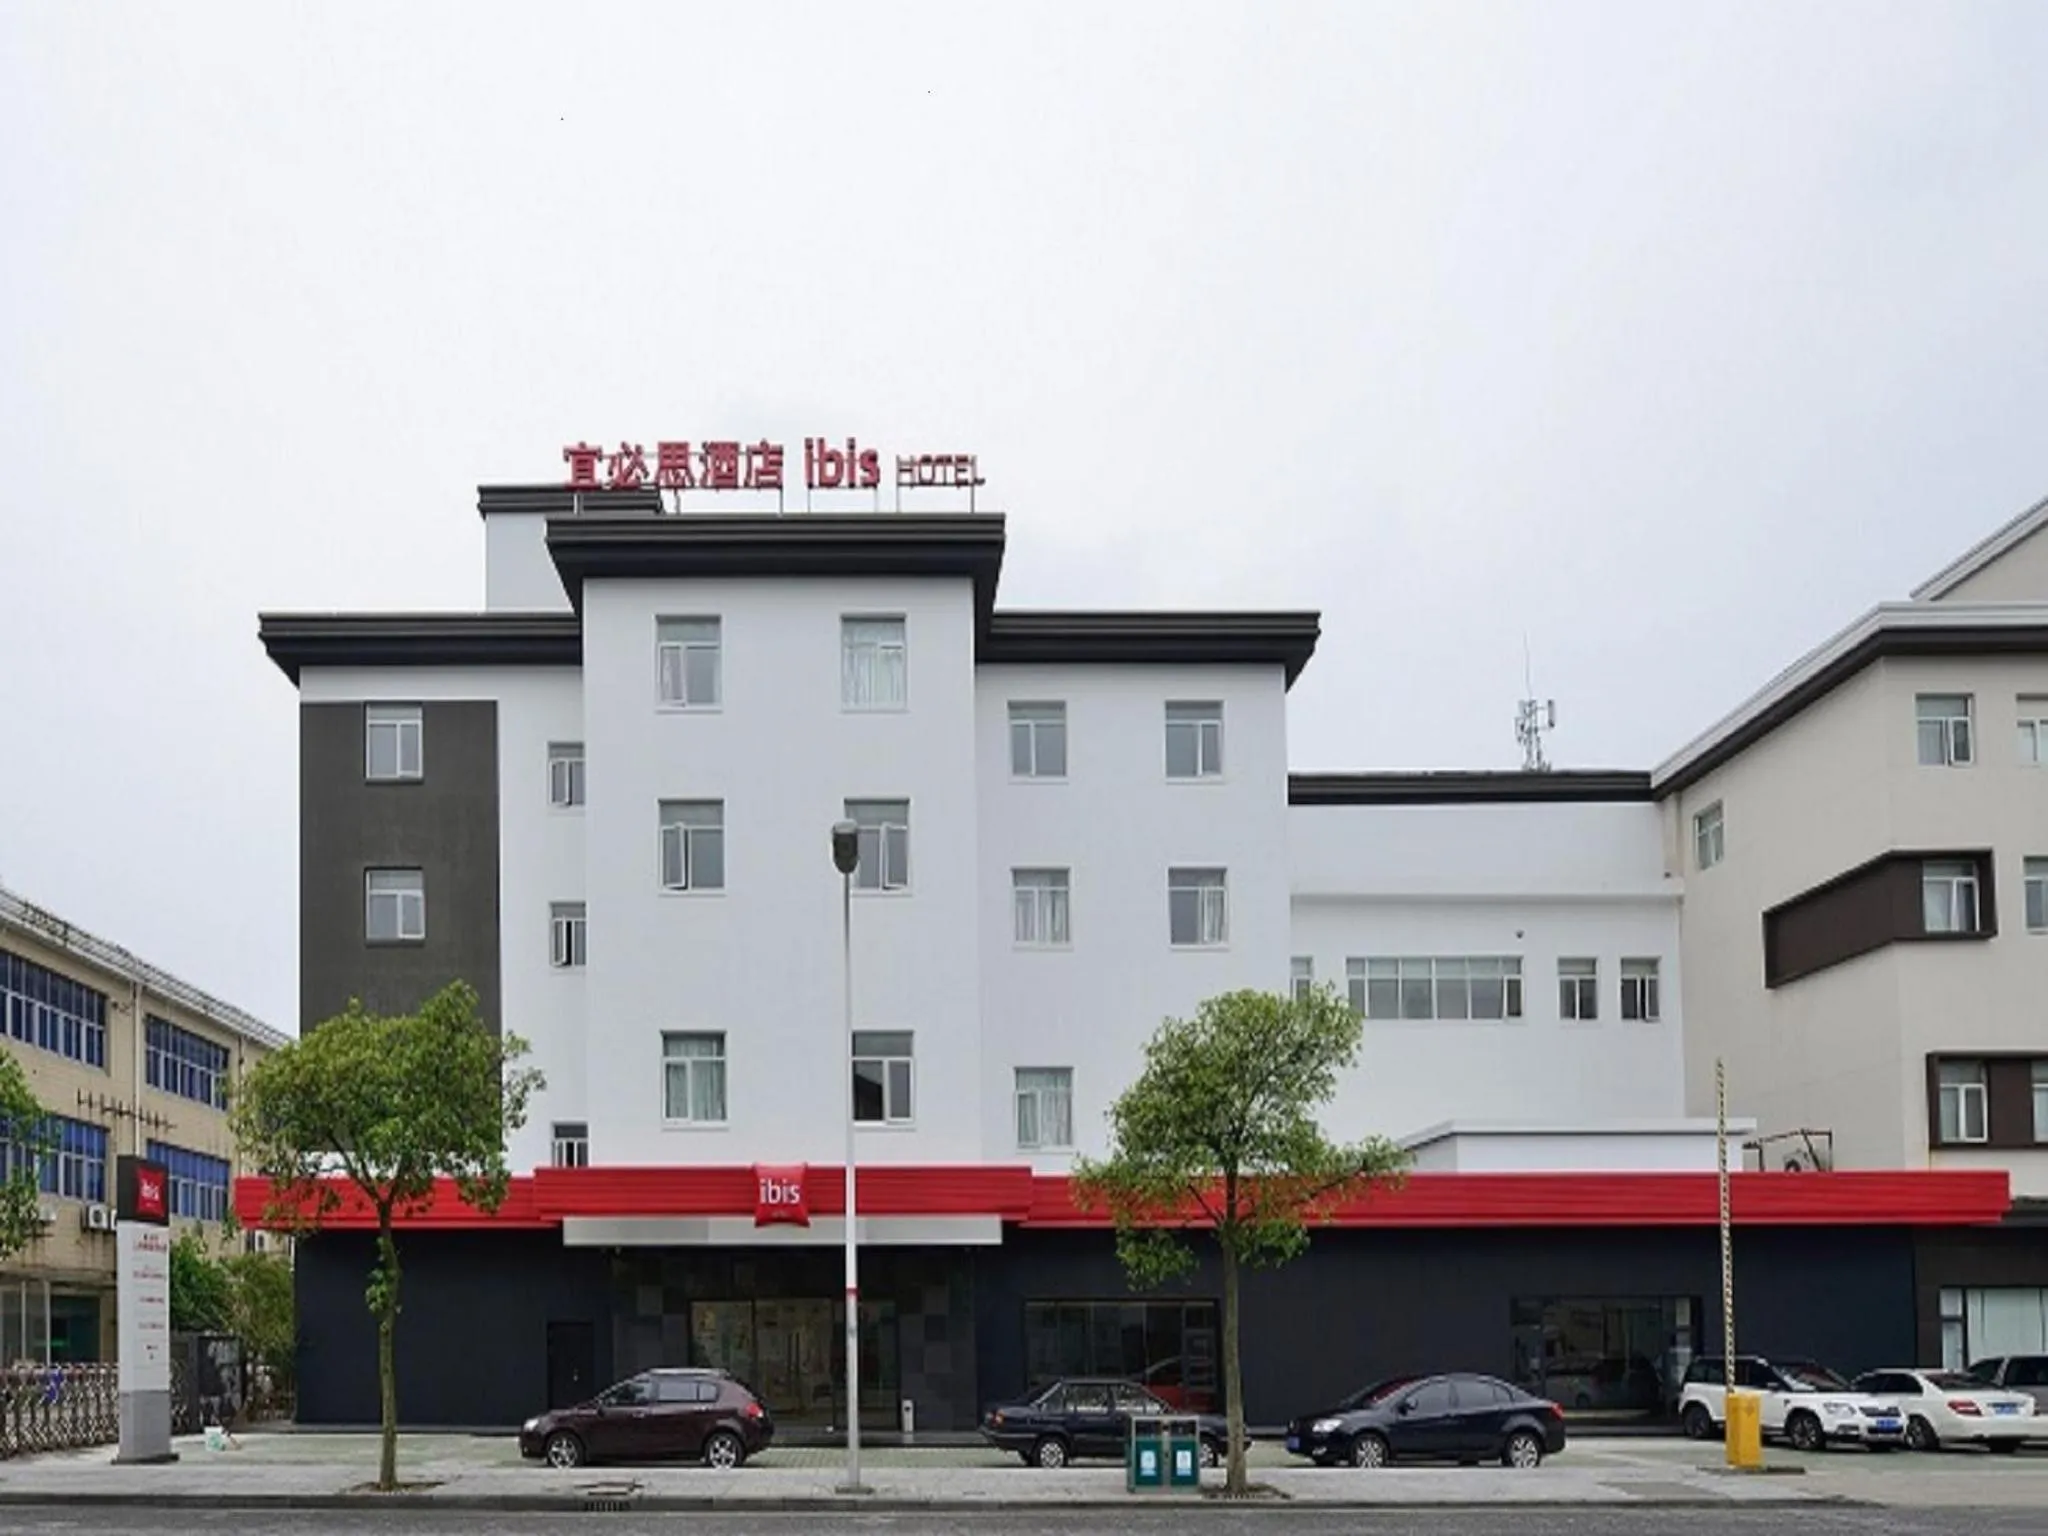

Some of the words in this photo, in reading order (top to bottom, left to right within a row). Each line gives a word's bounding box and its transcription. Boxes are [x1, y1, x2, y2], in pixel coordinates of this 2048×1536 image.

[563, 438, 783, 491] 宜必思酒店
[804, 437, 880, 489] ibis
[896, 454, 986, 487] HOTEL
[760, 1178, 800, 1204] ibis
